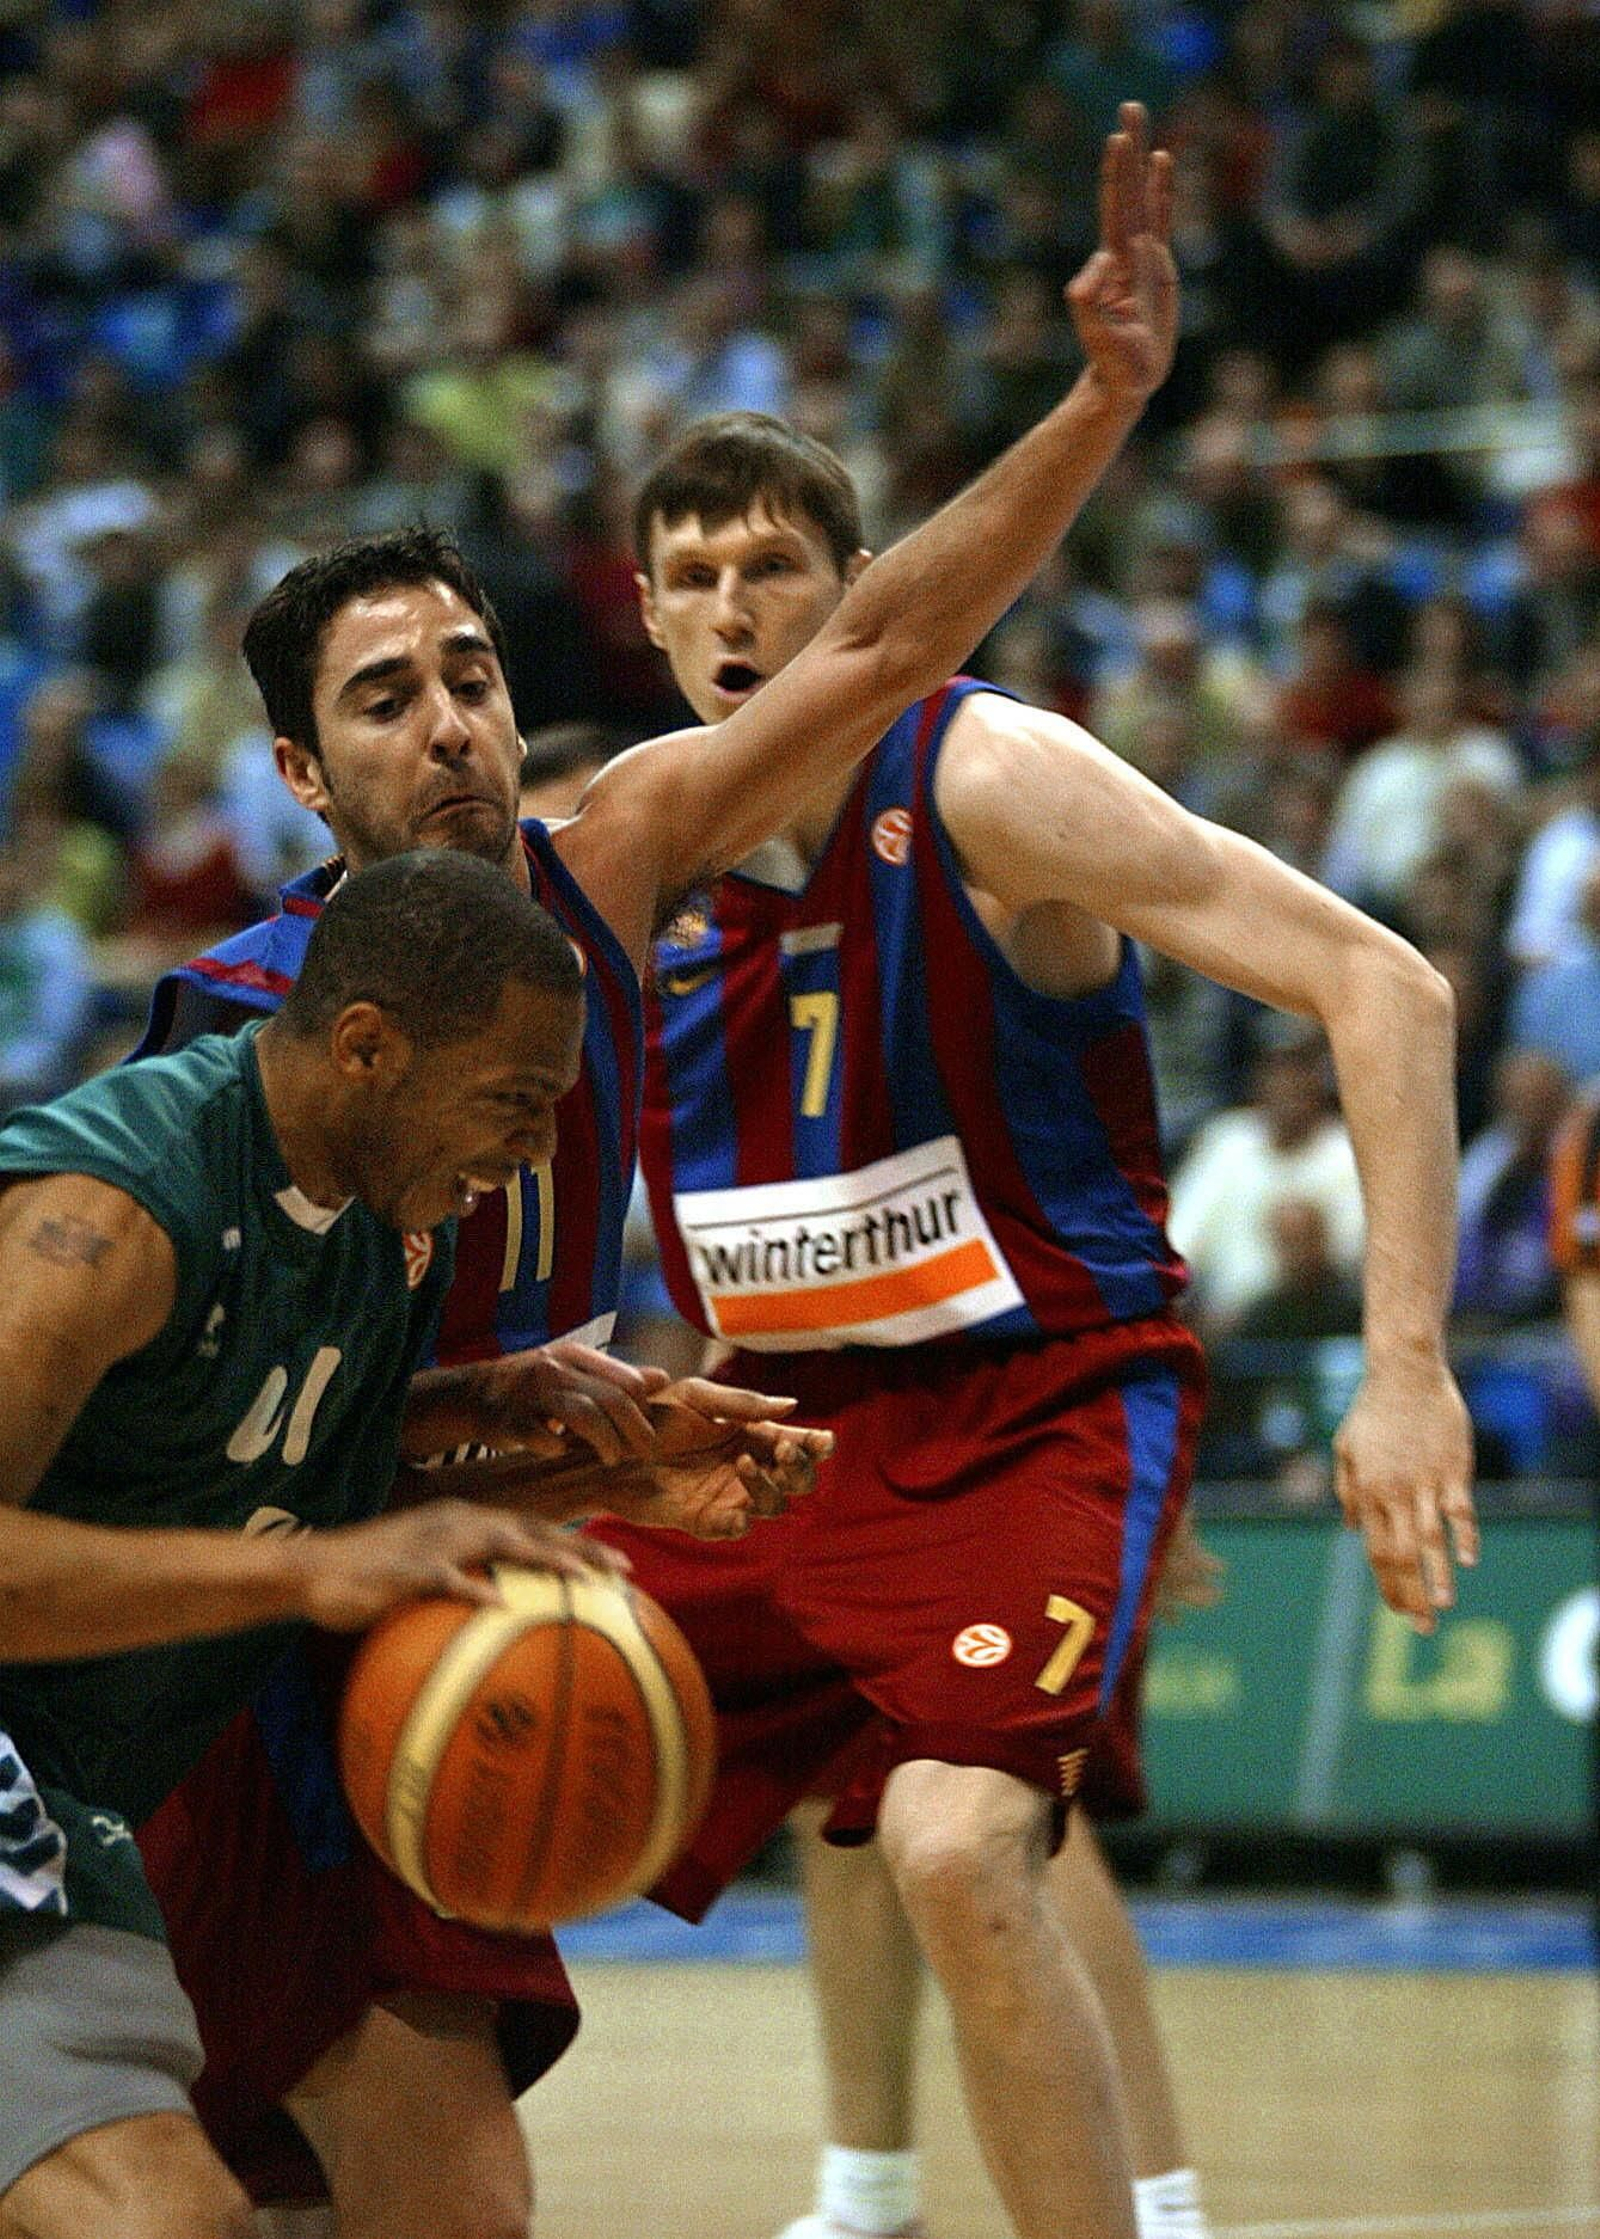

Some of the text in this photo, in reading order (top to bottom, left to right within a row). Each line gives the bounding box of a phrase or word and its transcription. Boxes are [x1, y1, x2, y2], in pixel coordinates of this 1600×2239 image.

[789, 991, 839, 1117] 7
[700, 1189, 960, 1284] winterthur
[1034, 1594, 1097, 1696] 7
